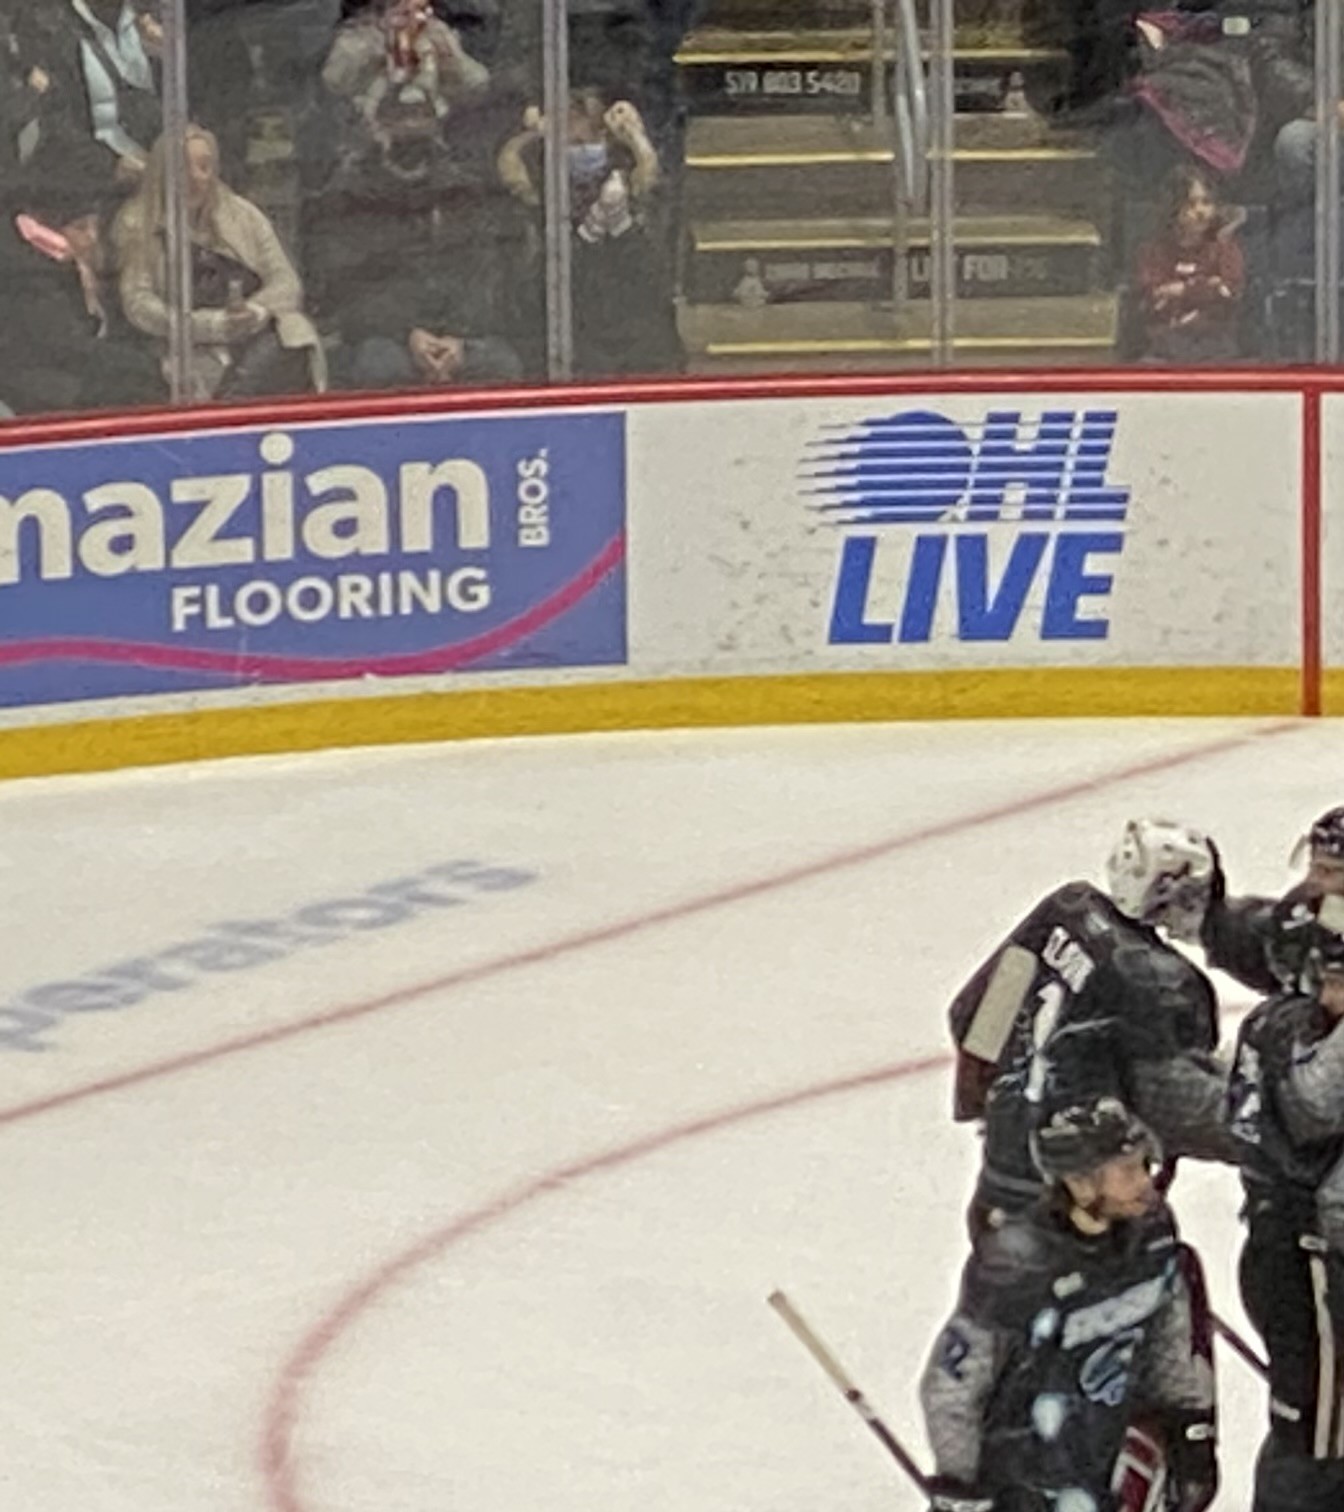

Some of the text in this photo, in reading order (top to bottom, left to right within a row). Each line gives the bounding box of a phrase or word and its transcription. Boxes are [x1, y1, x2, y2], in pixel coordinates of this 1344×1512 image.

[517, 448, 550, 548] BROS.
[171, 567, 491, 632] FLOORING
[829, 532, 1125, 645] LIVE
